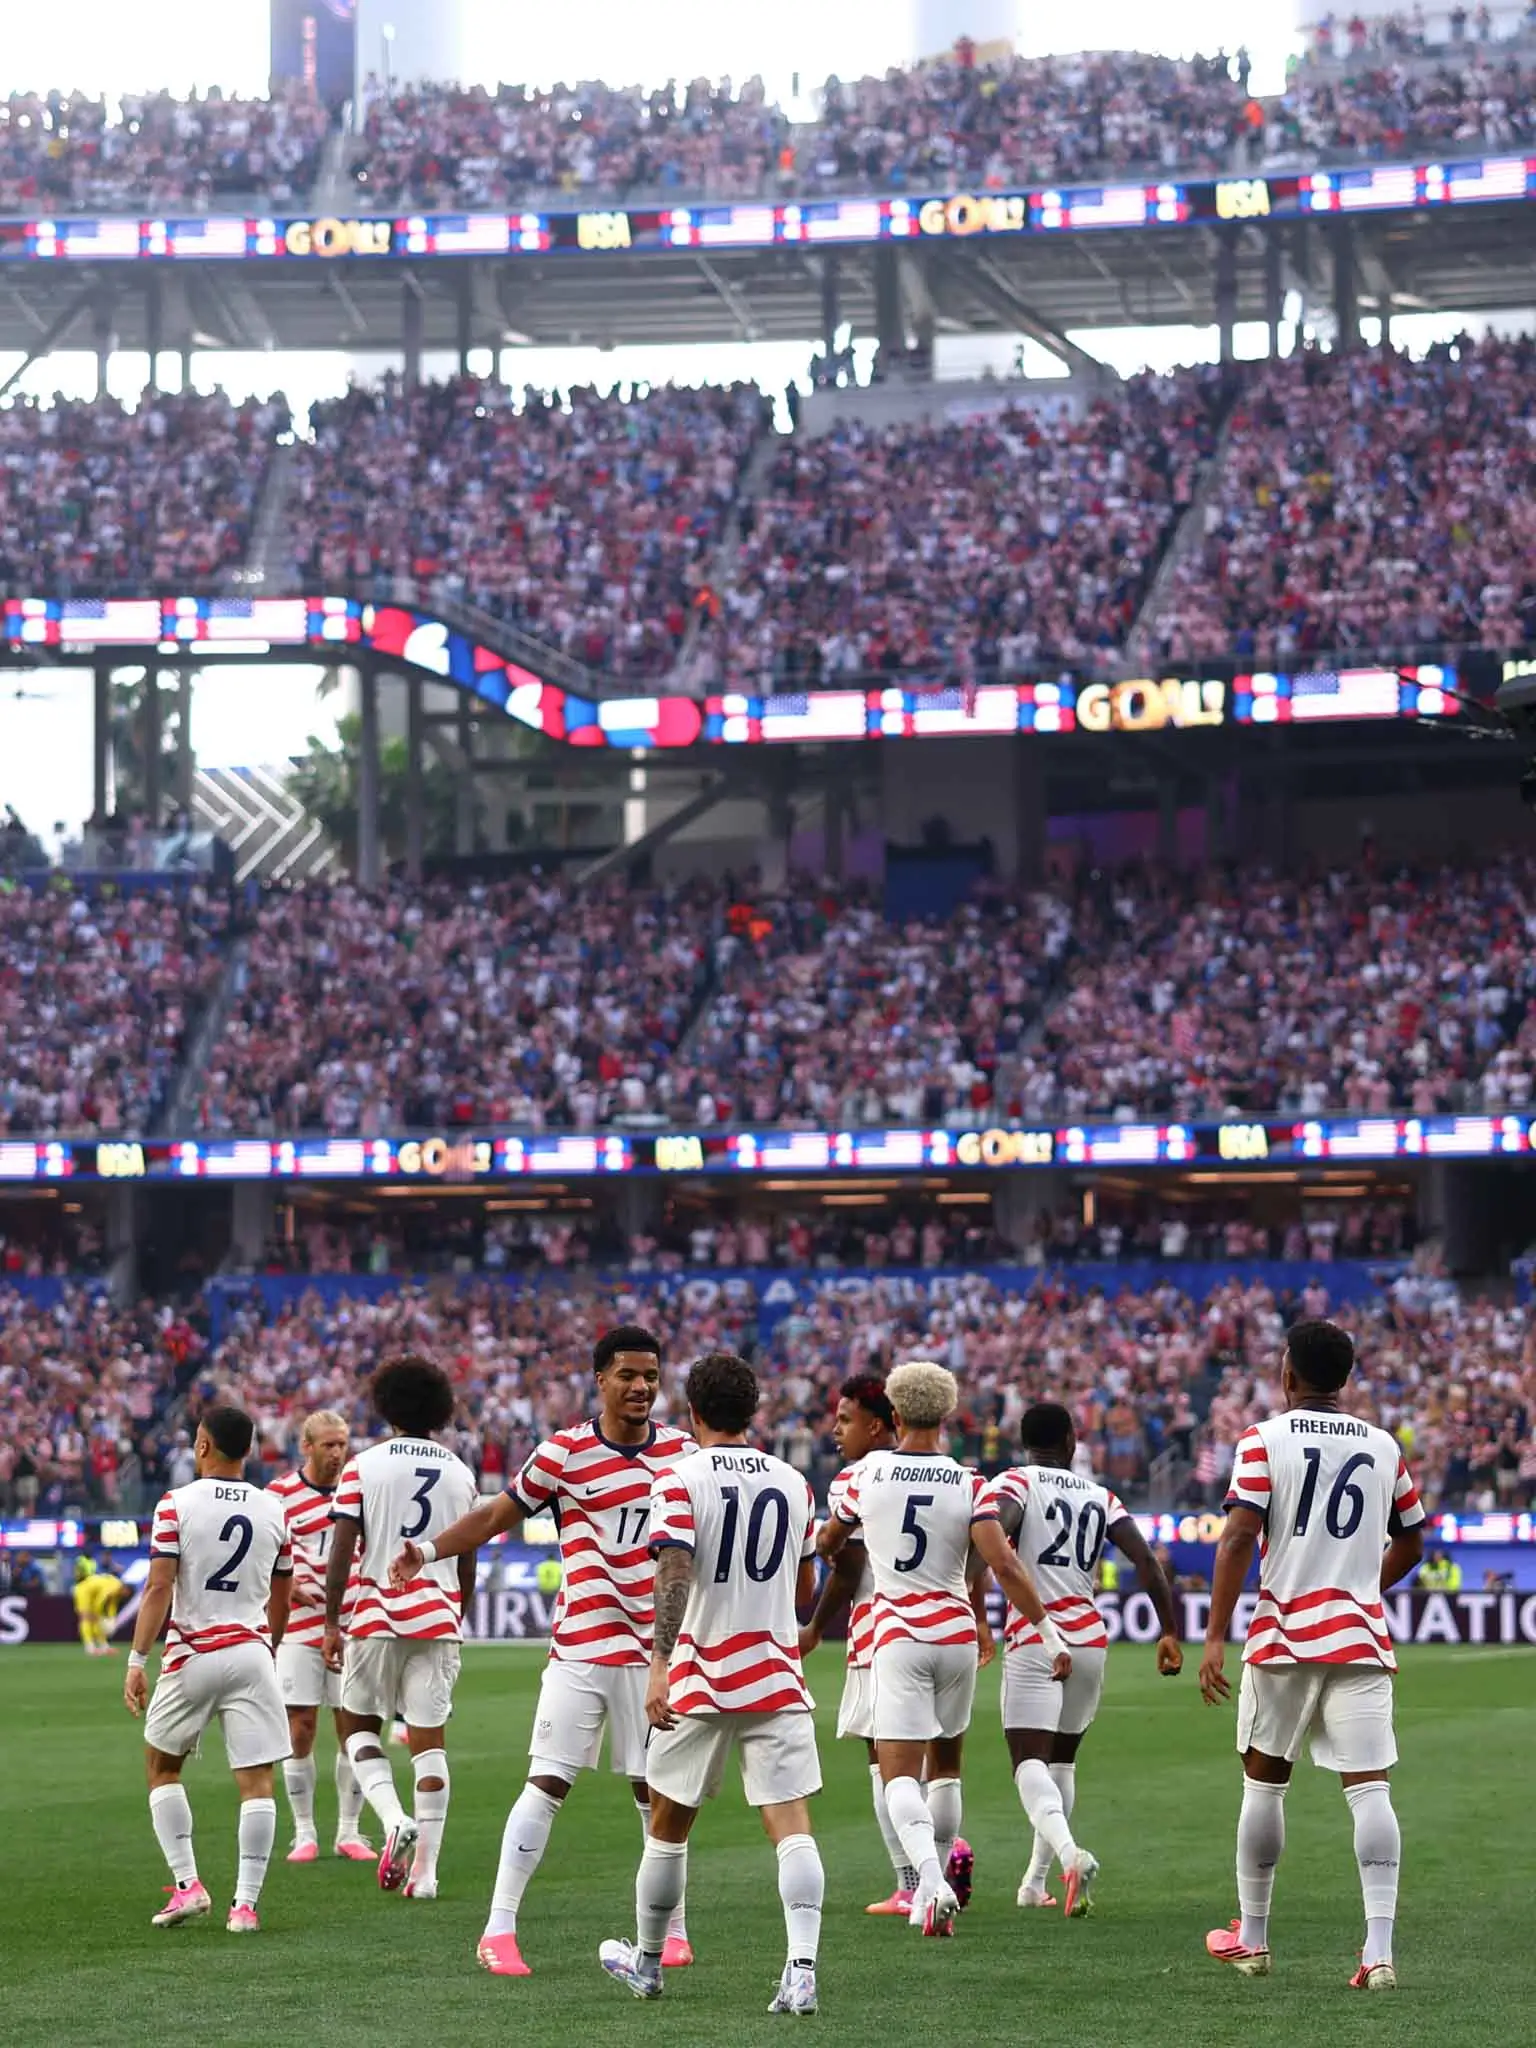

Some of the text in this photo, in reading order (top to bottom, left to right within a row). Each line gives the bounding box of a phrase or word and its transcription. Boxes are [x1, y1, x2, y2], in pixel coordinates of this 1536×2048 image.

[1076, 677, 1225, 732] GOAL!
[389, 1443, 454, 1462] RICHARDS
[1290, 1418, 1368, 1438] FREEMAN
[712, 1455, 770, 1473] PULISIC
[890, 1466, 964, 1486] ROBINSON
[215, 1486, 248, 1503] DEST
[400, 1467, 442, 1538] 3
[1292, 1447, 1376, 1540] 16
[204, 1514, 254, 1593] 2
[616, 1507, 650, 1545] 17
[713, 1486, 790, 1584] 10
[894, 1495, 934, 1573] 5
[1037, 1497, 1106, 1573] 20
